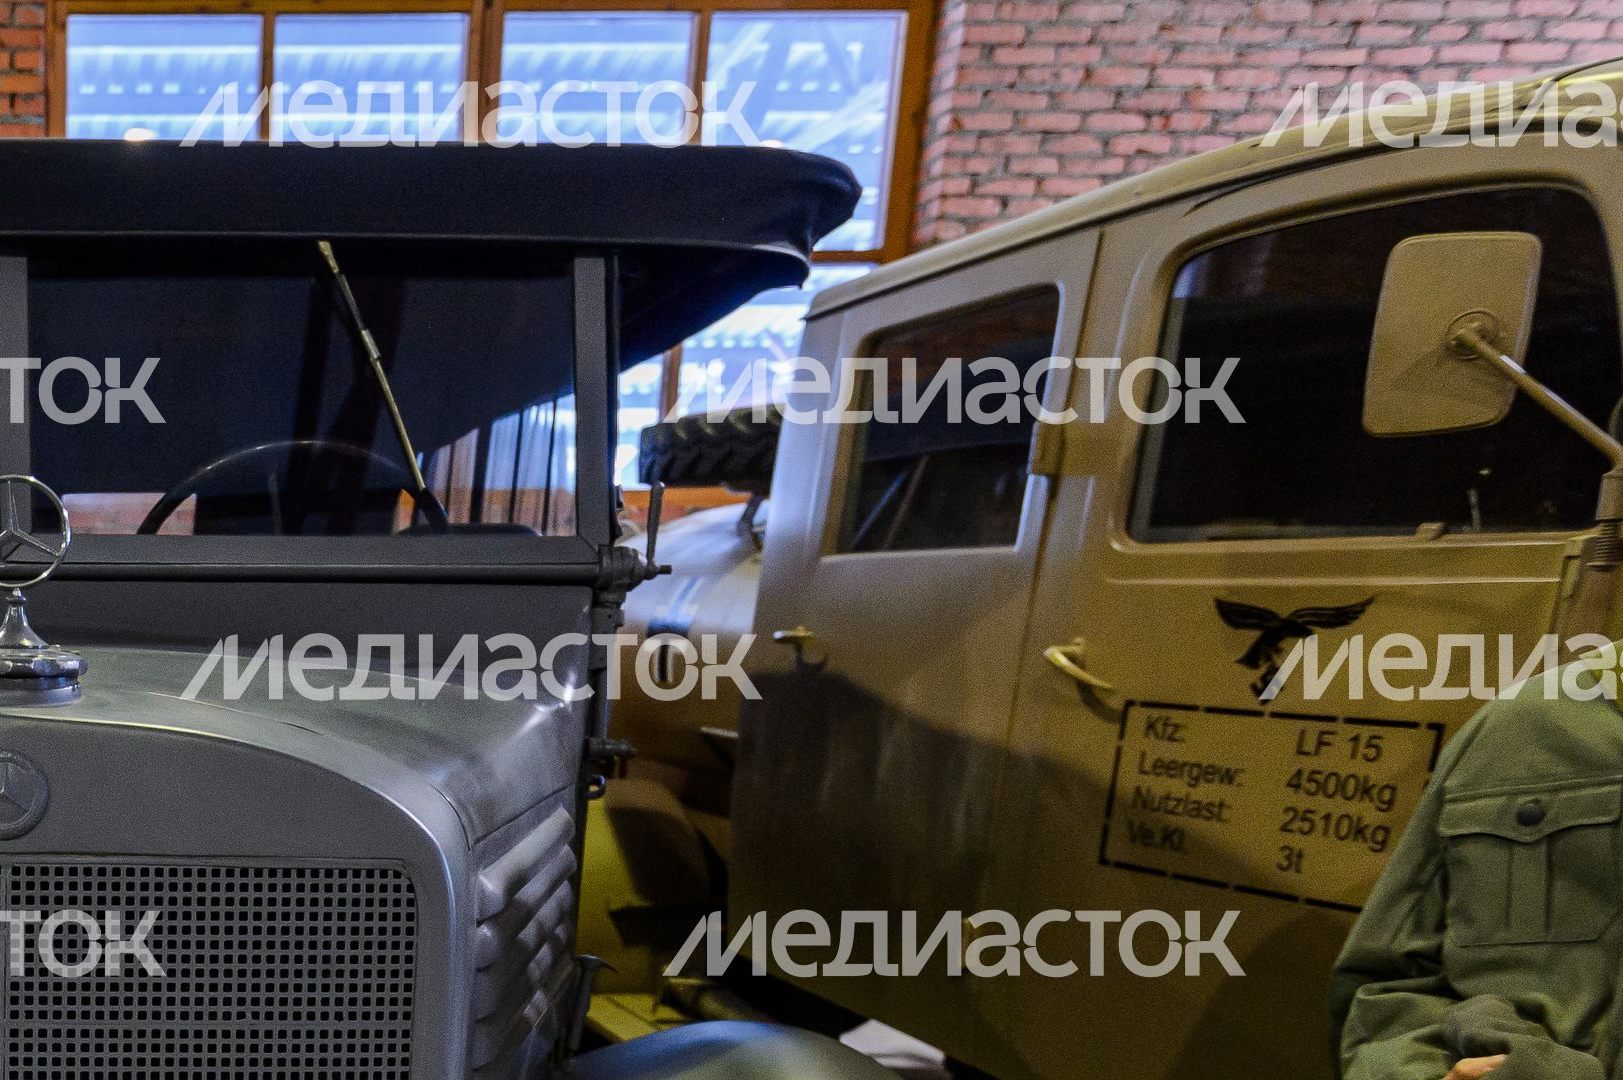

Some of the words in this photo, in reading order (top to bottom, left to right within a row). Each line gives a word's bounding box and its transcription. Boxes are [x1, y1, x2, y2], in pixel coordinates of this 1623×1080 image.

[1296, 728, 1337, 757] LF
[1348, 733, 1384, 763] 15
[1286, 767, 1398, 812] 4500kg
[1280, 806, 1392, 853] 2510kg
[1276, 844, 1304, 874] 3t
